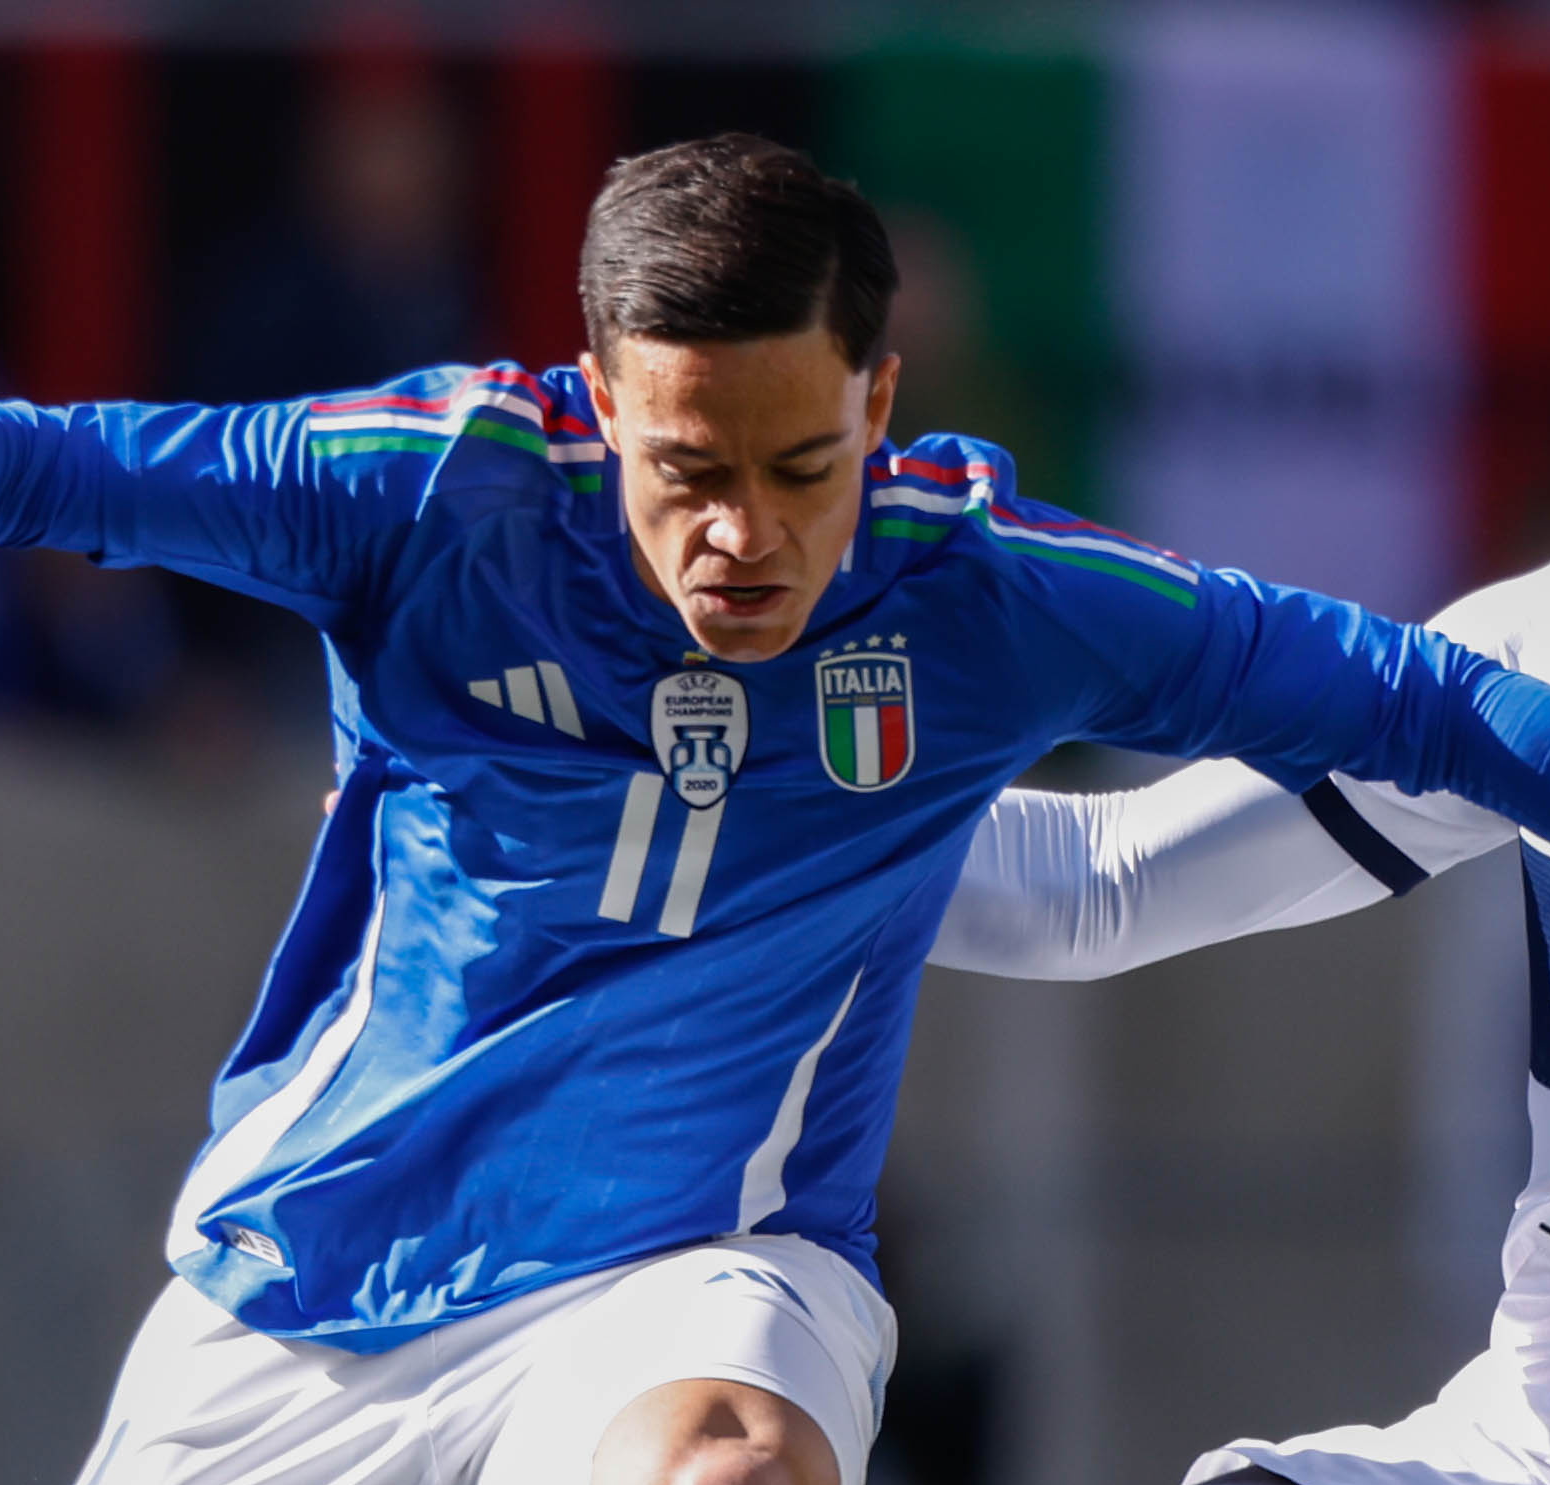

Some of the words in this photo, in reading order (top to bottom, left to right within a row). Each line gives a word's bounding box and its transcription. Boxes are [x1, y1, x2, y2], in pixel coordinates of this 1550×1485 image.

[676, 673, 721, 692] UEFA
[824, 665, 903, 695] ITALIA
[665, 695, 734, 707] EUROPEAN
[665, 707, 734, 718] CHAMPIONS
[684, 779, 719, 792] 2020
[597, 771, 727, 938] 11
